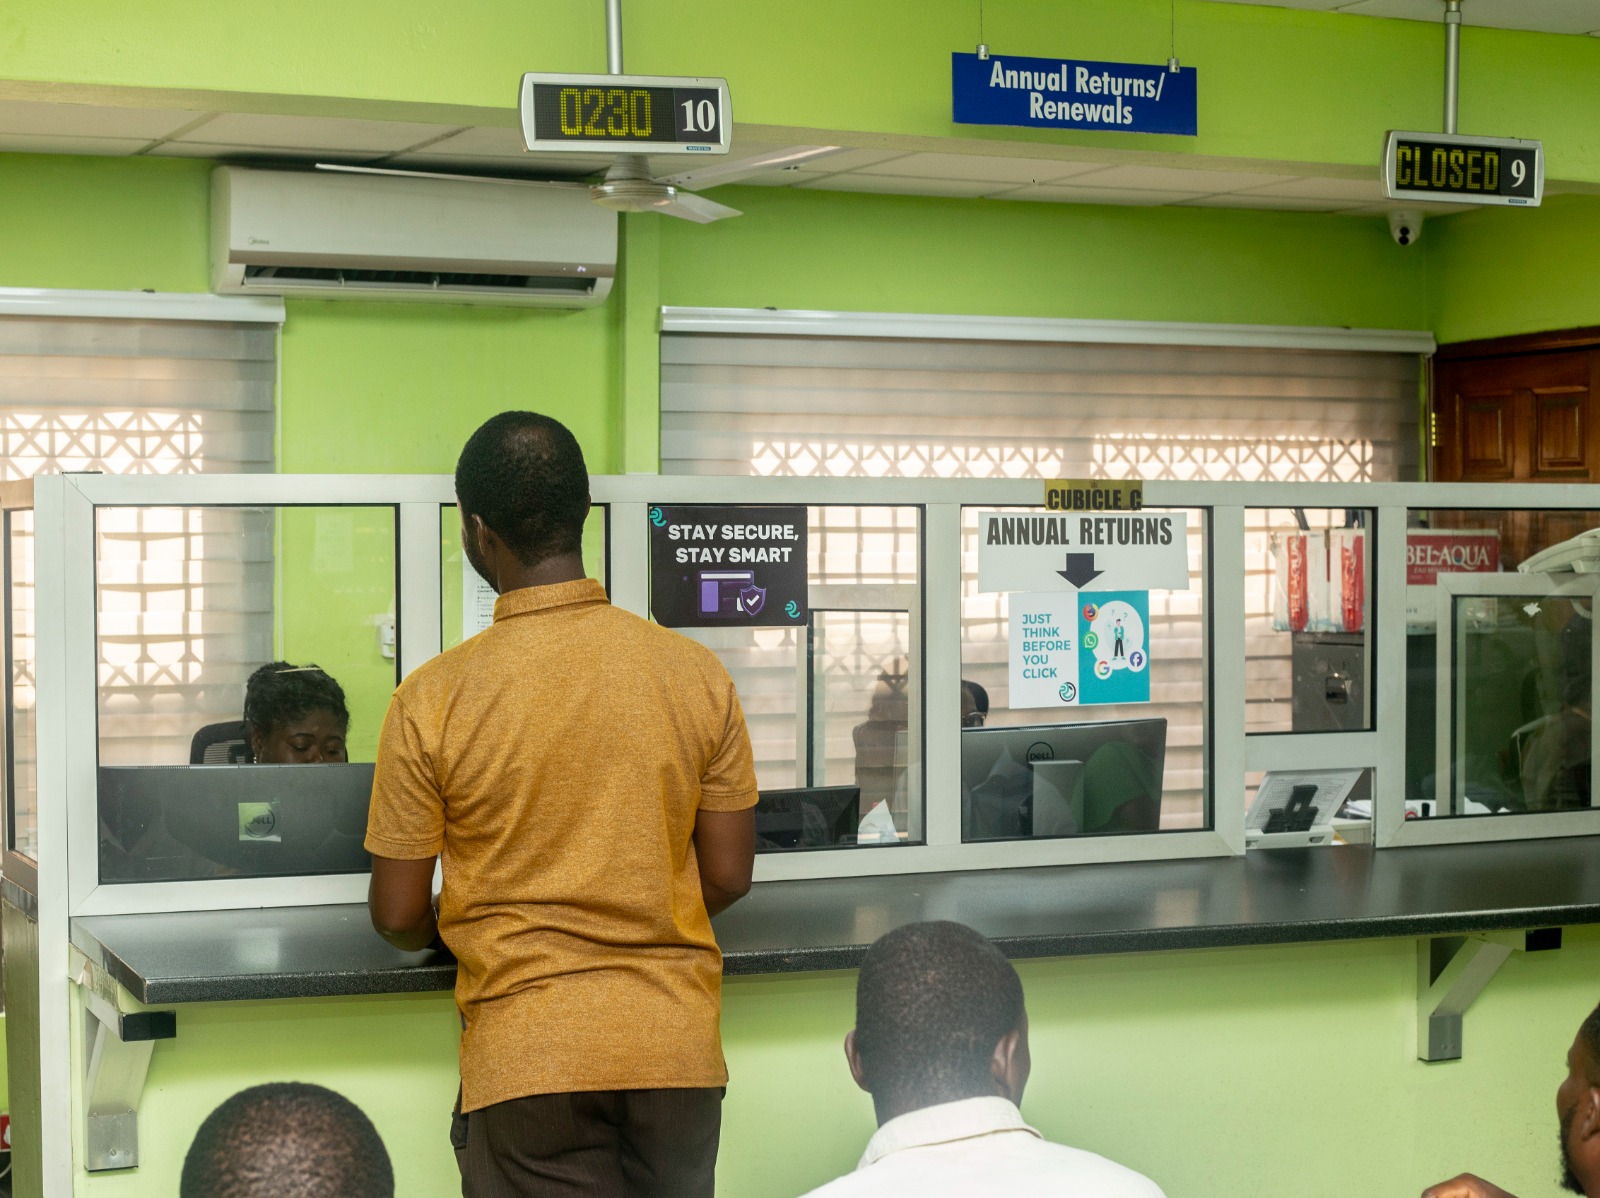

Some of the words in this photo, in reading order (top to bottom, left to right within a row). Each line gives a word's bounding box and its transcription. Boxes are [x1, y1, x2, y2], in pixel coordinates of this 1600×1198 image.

[989, 61, 1067, 92] Annual
[1075, 67, 1166, 101] Returns/
[560, 88, 652, 137] 0230
[681, 99, 716, 132] 10
[1029, 92, 1133, 125] Renewals
[1396, 145, 1499, 190] CLOSED
[1510, 159, 1526, 188] 9
[1047, 488, 1122, 510] CUBICLE
[668, 524, 717, 540] STAY
[721, 524, 799, 541] SECURE,
[987, 517, 1070, 545] ANNUAL
[1080, 517, 1173, 546] RETURNS
[675, 547, 725, 563] STAY
[728, 547, 792, 563] SMART
[1022, 613, 1052, 625] JUST
[1022, 627, 1060, 638] THINK
[1023, 640, 1071, 652] BEFORE
[1023, 654, 1049, 665] YOU
[1023, 667, 1057, 679] CLICK
[1030, 752, 1051, 761] DELL
